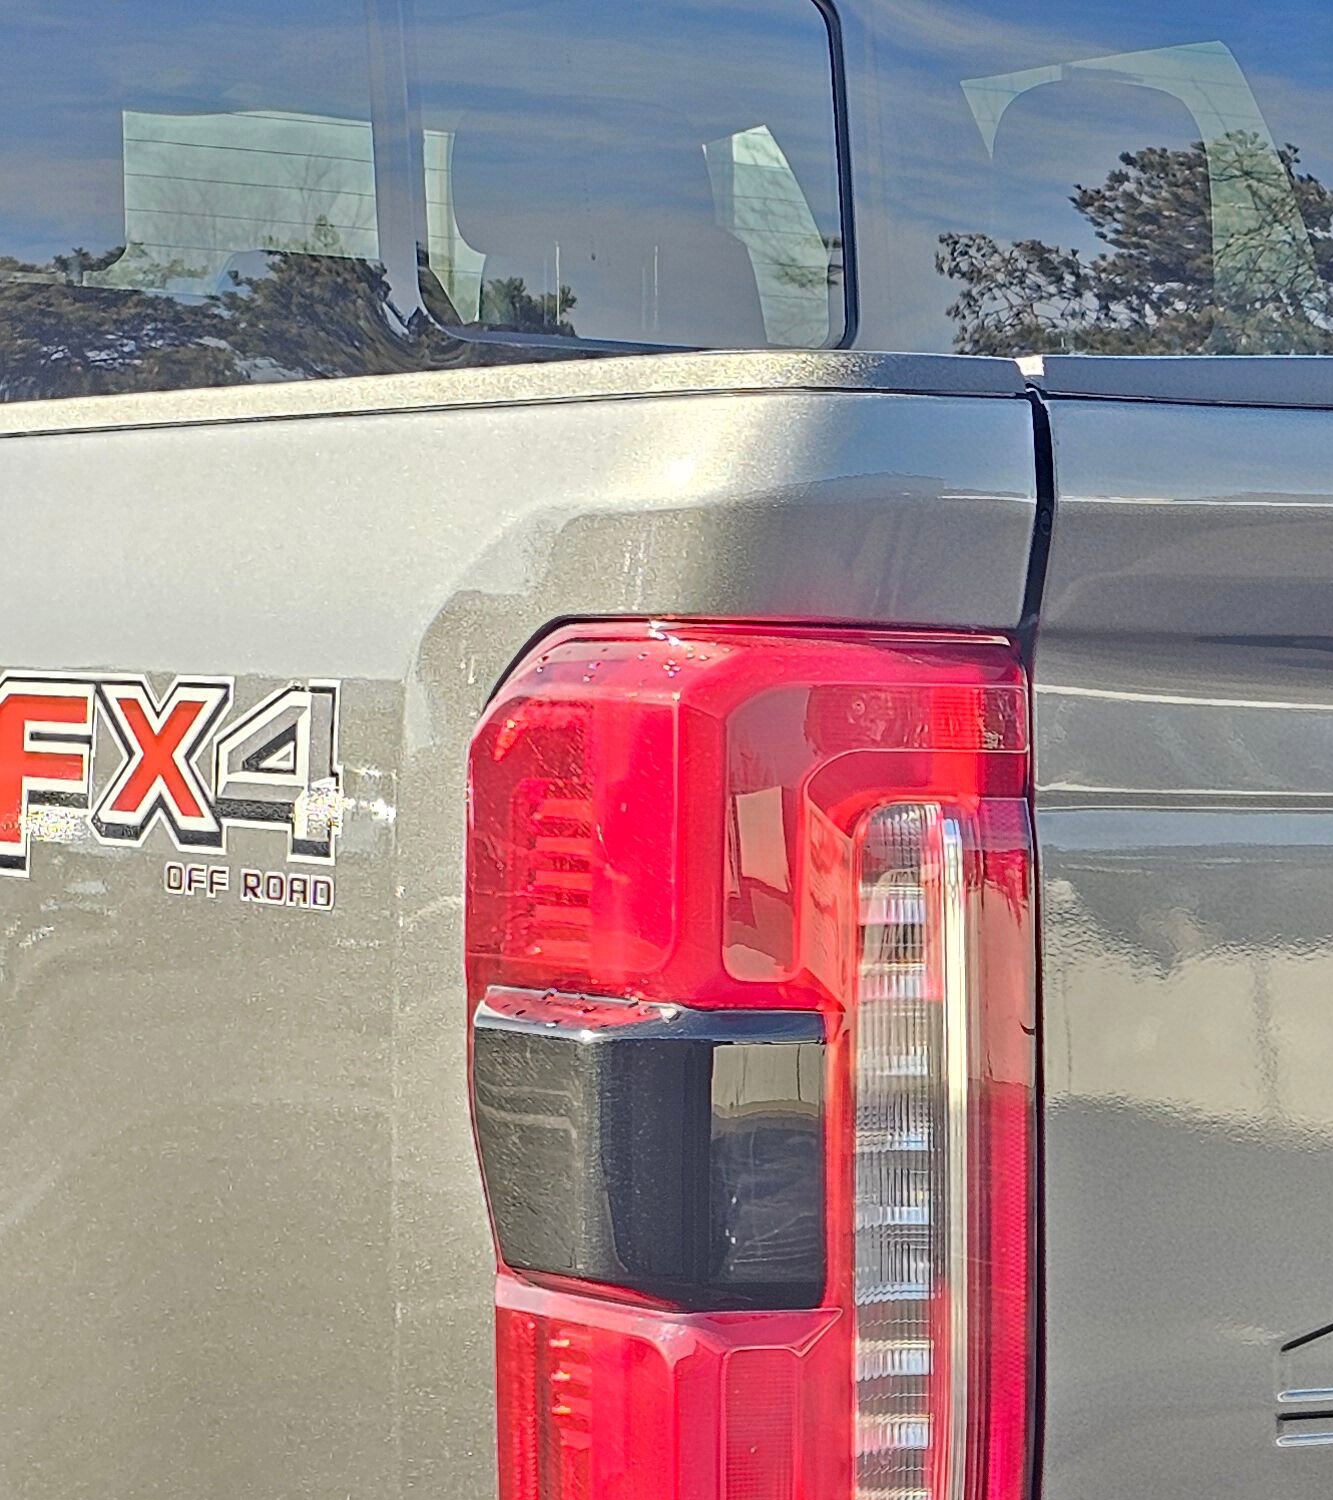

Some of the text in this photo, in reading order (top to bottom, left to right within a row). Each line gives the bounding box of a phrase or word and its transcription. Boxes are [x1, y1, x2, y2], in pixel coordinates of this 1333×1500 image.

[0, 671, 343, 878] FX4
[165, 863, 336, 910] OFF ROAD
